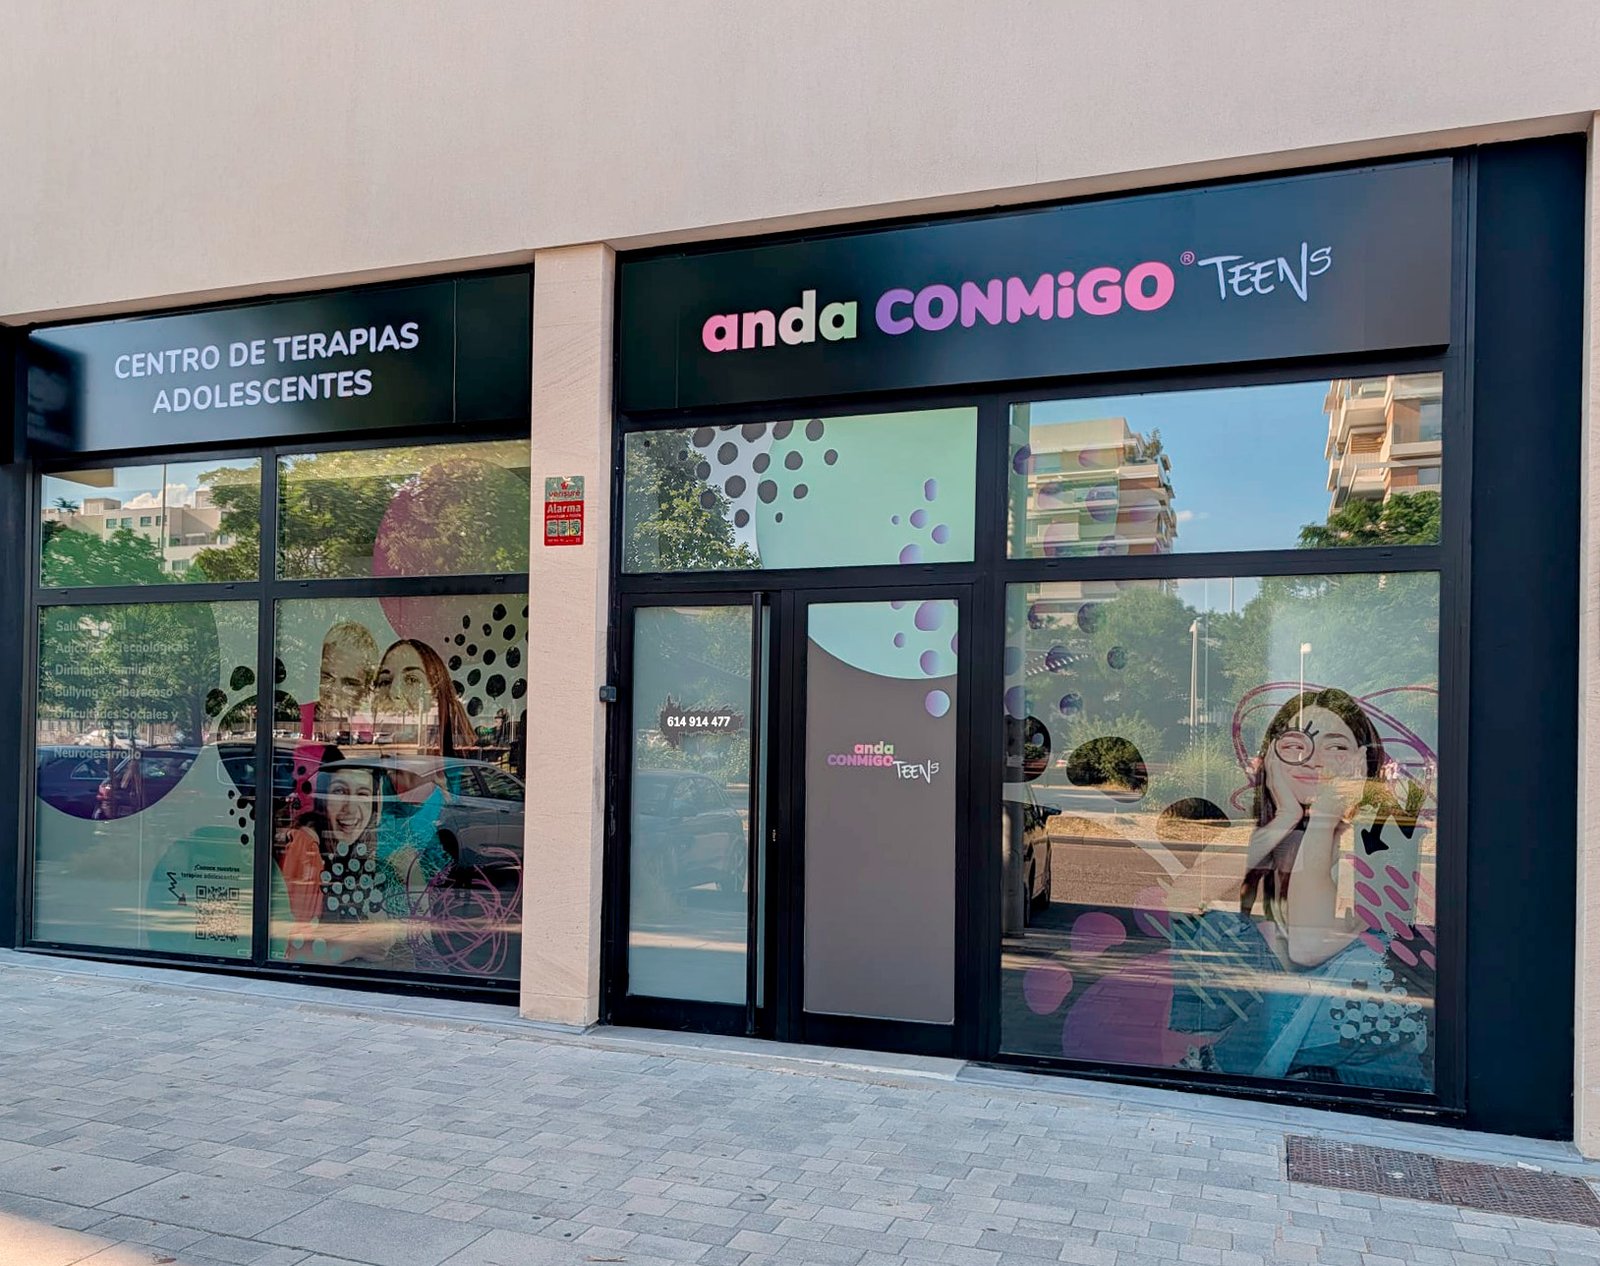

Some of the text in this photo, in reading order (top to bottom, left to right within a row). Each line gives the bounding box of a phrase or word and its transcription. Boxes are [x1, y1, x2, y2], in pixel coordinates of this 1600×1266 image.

[702, 289, 858, 353] anda
[114, 321, 420, 379] CENTRO DE TERAPIAS
[152, 368, 373, 414] ADOLESCENTES
[547, 504, 581, 513] Alarma
[55, 620, 85, 632] Salu
[55, 685, 98, 698] Bullying
[122, 708, 168, 719] Sociales
[172, 711, 178, 720] y
[667, 716, 730, 727] 614 914 477
[54, 748, 141, 760] Neurodesarrollo
[854, 741, 894, 755] anda
